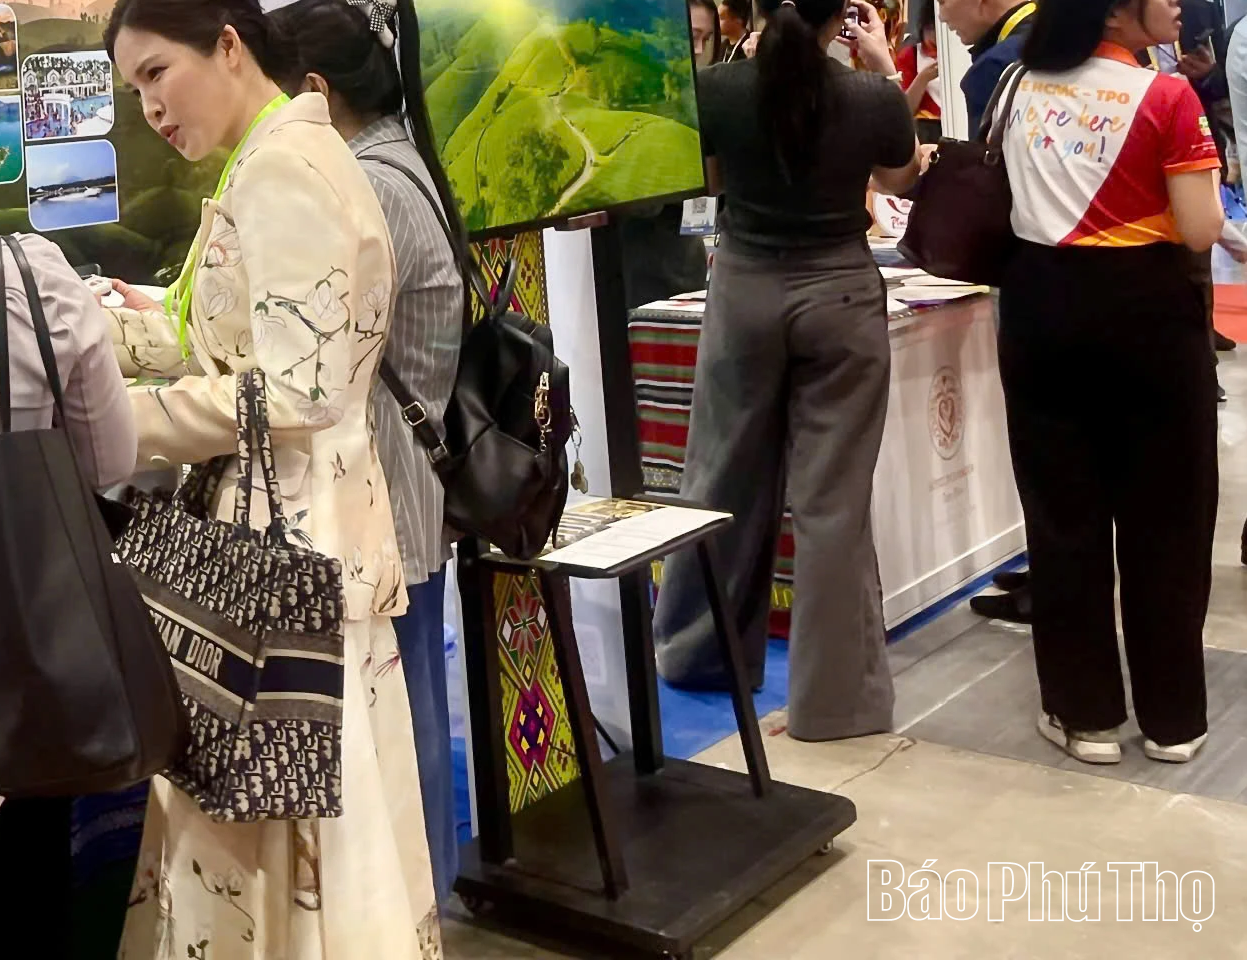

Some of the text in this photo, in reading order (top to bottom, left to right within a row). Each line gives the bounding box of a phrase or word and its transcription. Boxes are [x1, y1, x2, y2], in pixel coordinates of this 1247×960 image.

[1007, 96, 1126, 133] We're here
[1096, 89, 1130, 105] TPO
[1027, 126, 1105, 162] for you!
[185, 634, 223, 680] DIOR
